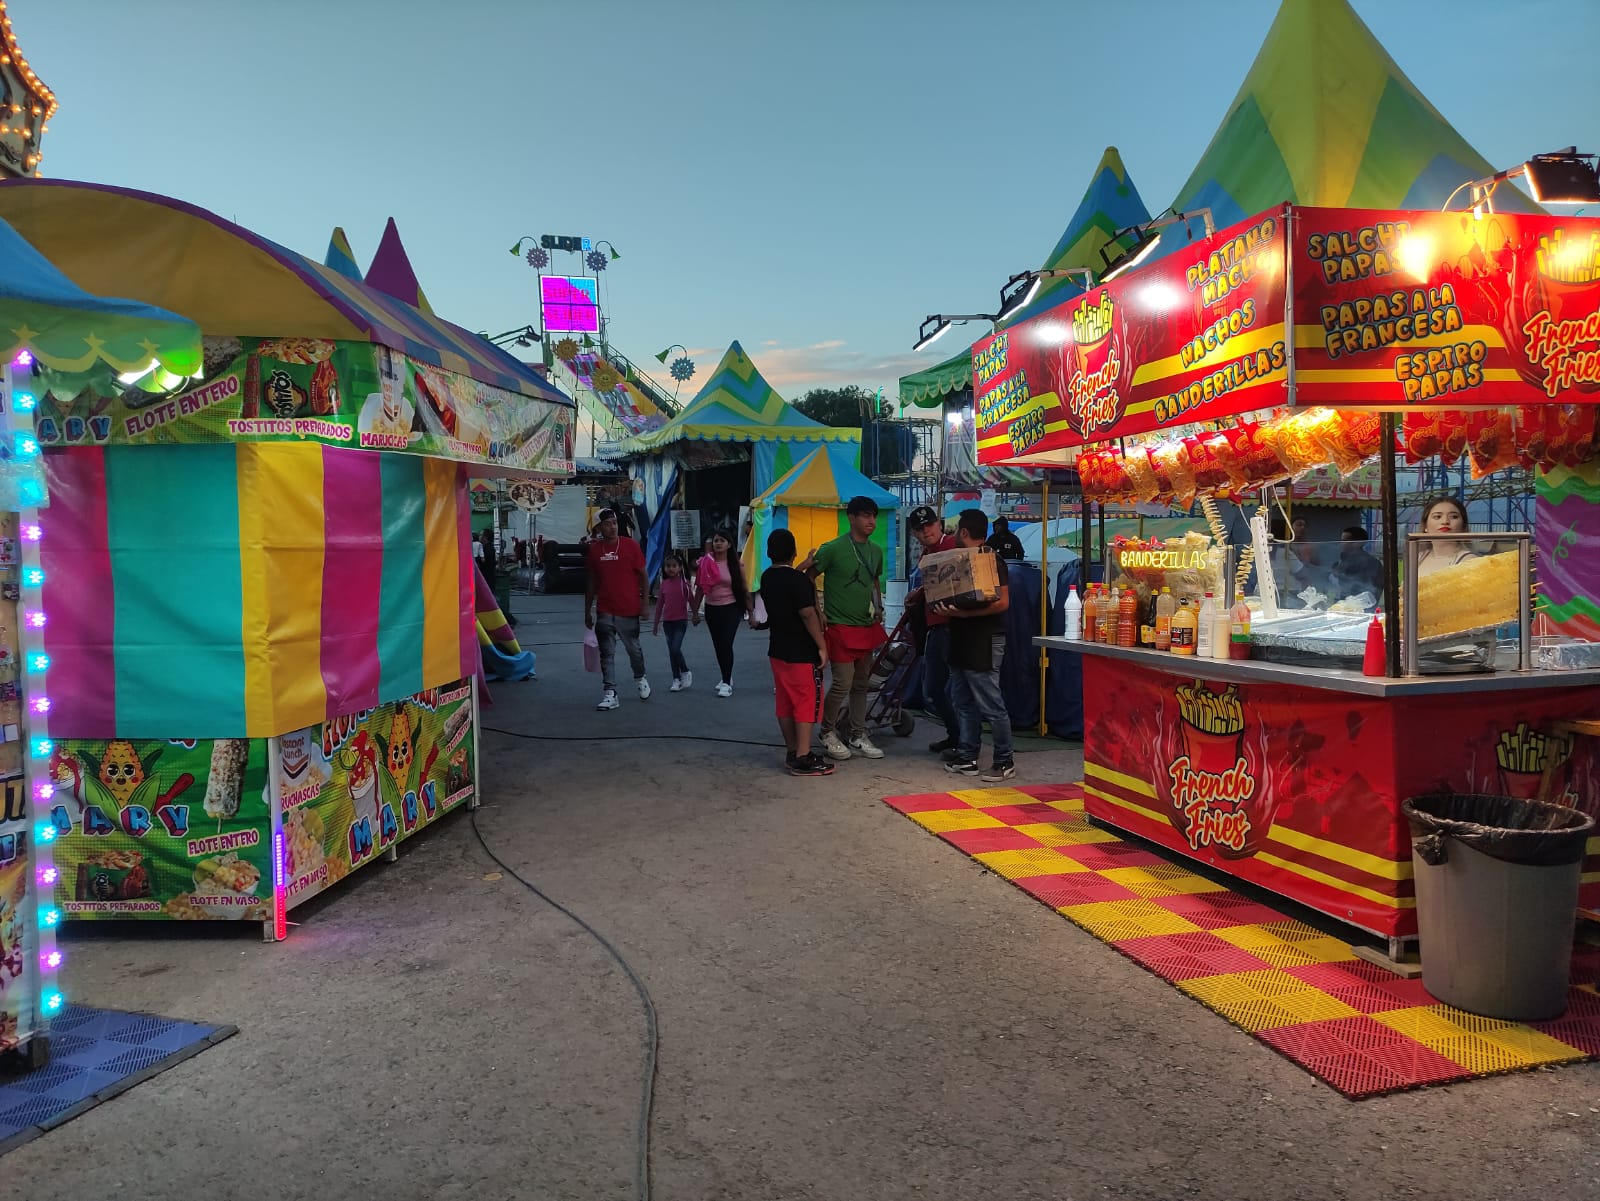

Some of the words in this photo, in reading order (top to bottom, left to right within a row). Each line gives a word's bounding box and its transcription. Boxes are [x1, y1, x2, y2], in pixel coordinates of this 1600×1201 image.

[1186, 217, 1276, 292] PLATANO
[1321, 291, 1407, 331] PAPAS
[1412, 290, 1426, 313] A
[1430, 284, 1454, 307] LA
[974, 332, 1009, 371] SALCHI
[1180, 299, 1256, 369] NACHOS
[1326, 307, 1464, 360] FRANCESA
[1523, 310, 1600, 364] Frenc
[978, 351, 1008, 386] PAPAS
[1069, 349, 1121, 414] French
[1154, 340, 1286, 425] BANDERILLAS
[1396, 341, 1487, 381] ESPIRO
[1403, 363, 1484, 403] PAPAS
[126, 402, 175, 435] ELOTE
[178, 376, 238, 415] ENTERO
[979, 380, 1008, 413] PAPAS
[1009, 375, 1015, 393] A
[1016, 369, 1026, 388] LA
[982, 385, 1030, 432] FRANCESA
[37, 417, 111, 443] ARY
[229, 420, 293, 434] TOSTITOS
[295, 420, 352, 439] PREPARADOS
[1008, 405, 1045, 442] ESPIRO
[1080, 389, 1120, 439] Fries
[1012, 422, 1046, 456] PAPAS
[1120, 551, 1209, 569] BANDERILLAS
[281, 783, 320, 810] RUCHASCAS
[1169, 756, 1255, 809] French
[188, 837, 219, 856] ELOTE
[220, 830, 259, 848] ENTERO
[348, 780, 437, 866] MARY
[1184, 799, 1251, 851] Fries
[65, 902, 108, 911] TOSTITOS
[109, 902, 160, 911] PREPARADOS
[190, 895, 219, 905] ELOTE
[221, 896, 233, 905] EN
[235, 896, 260, 905] VASO
